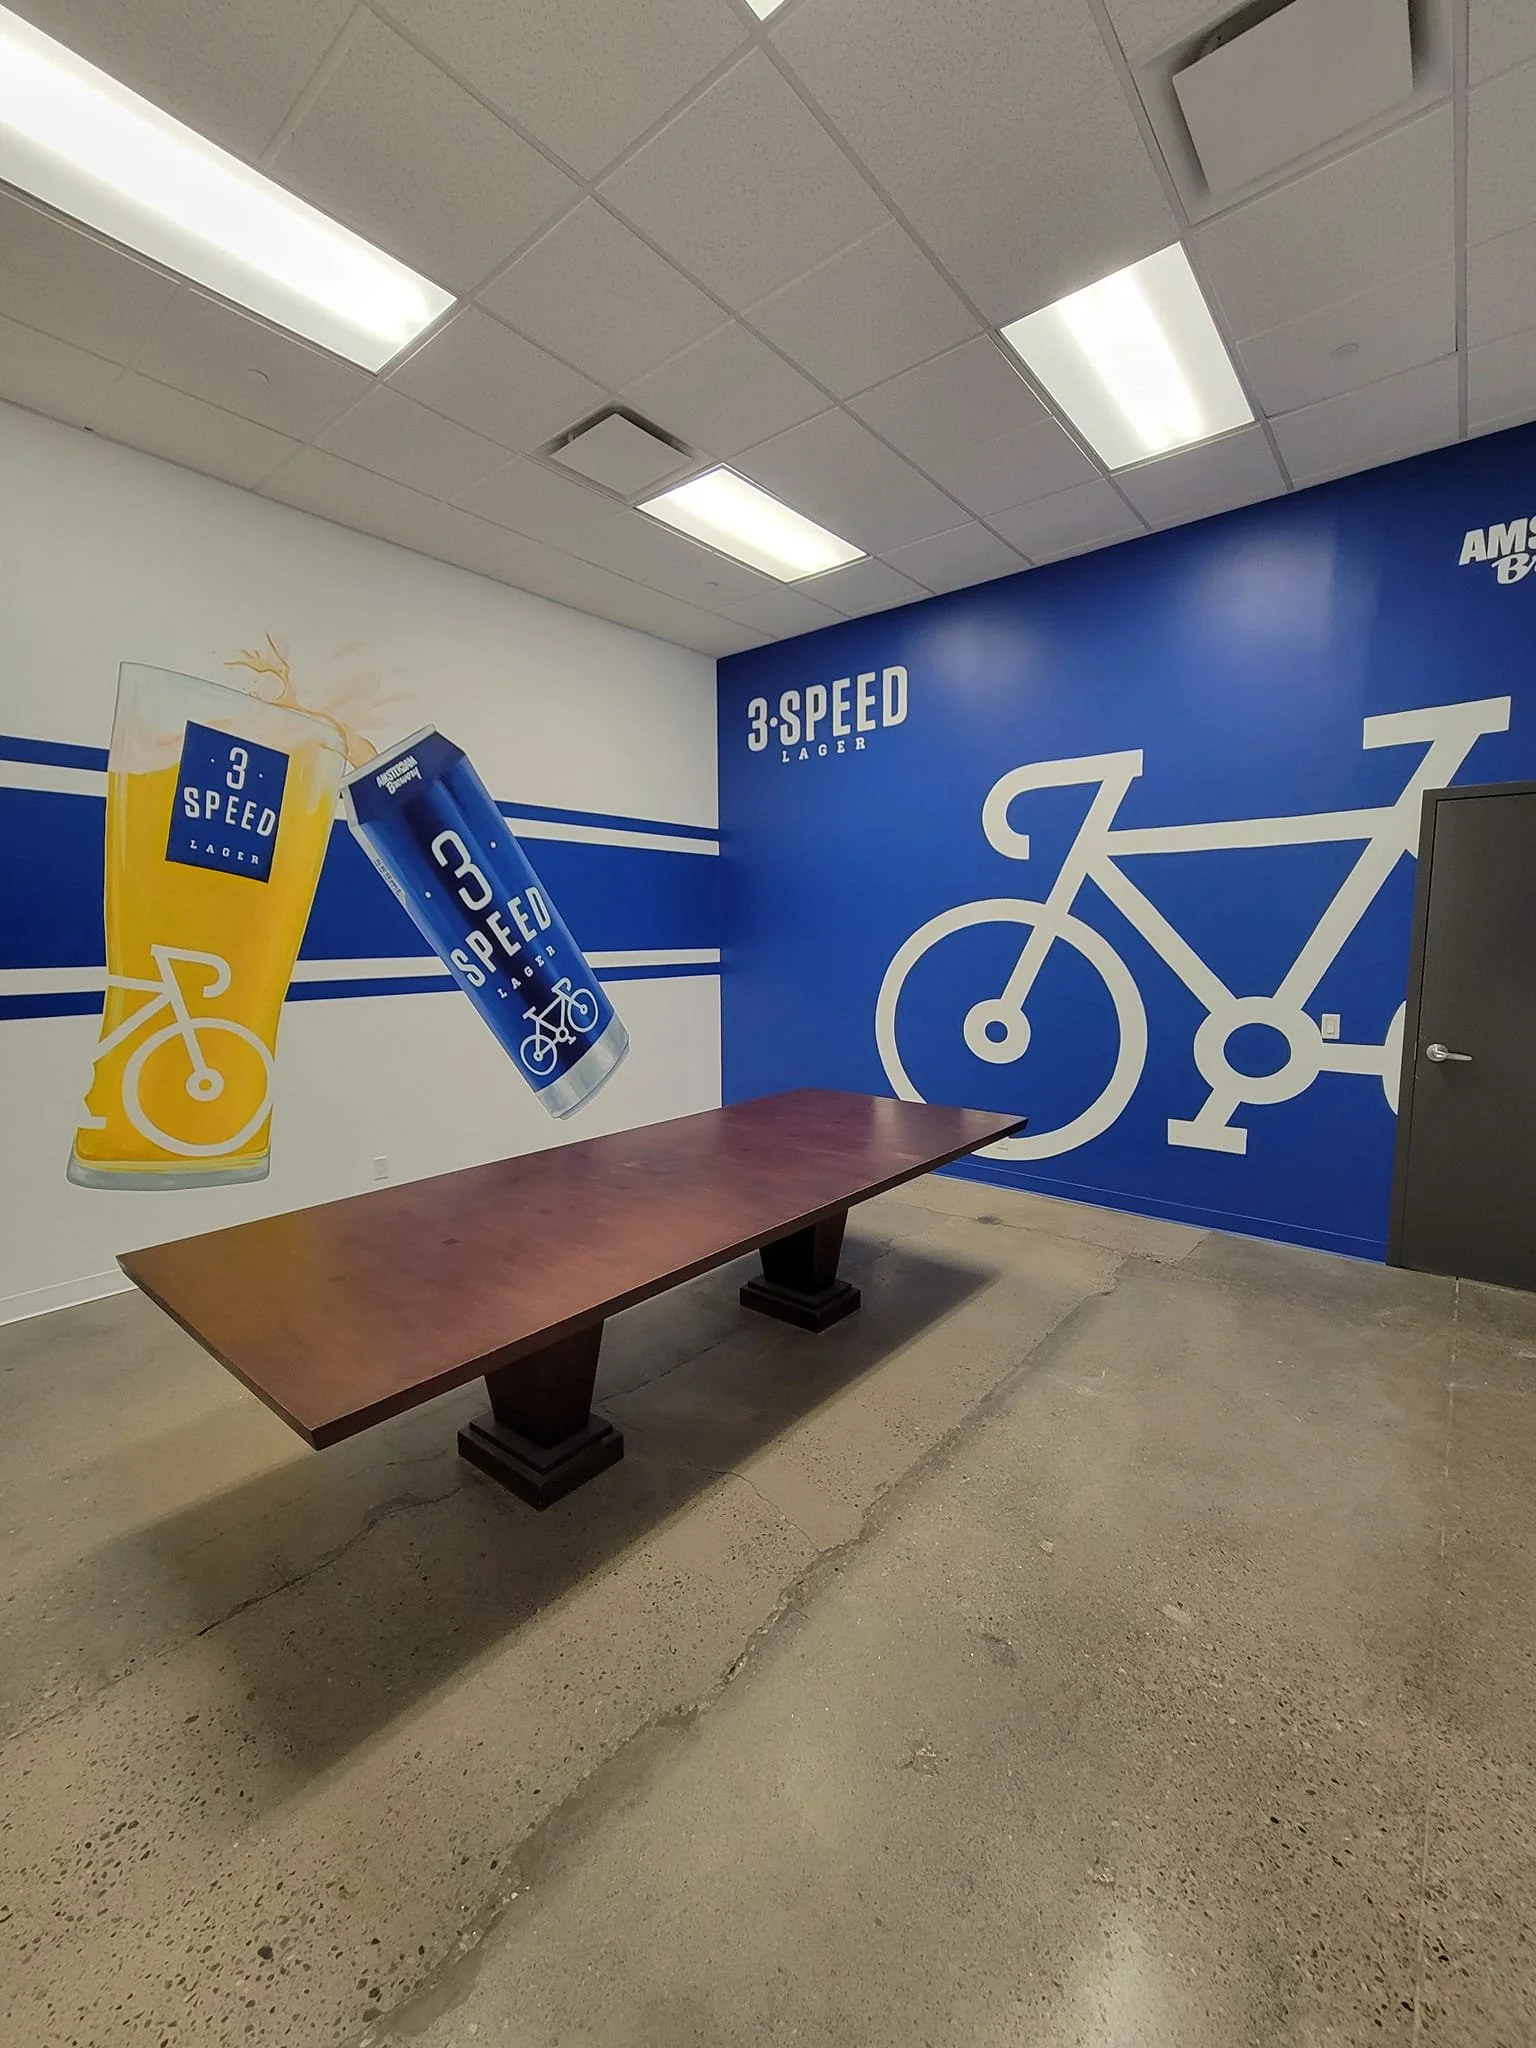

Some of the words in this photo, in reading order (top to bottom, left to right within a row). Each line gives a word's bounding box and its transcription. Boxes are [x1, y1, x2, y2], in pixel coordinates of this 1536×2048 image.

[1491, 552, 1536, 585] B
[226, 746, 249, 790] 3
[782, 737, 866, 763] LAGER
[183, 786, 276, 837] SPEED
[190, 839, 260, 865] LAGER
[431, 829, 493, 911] 3
[450, 886, 551, 988] SPEED
[497, 945, 556, 999] LAGER
